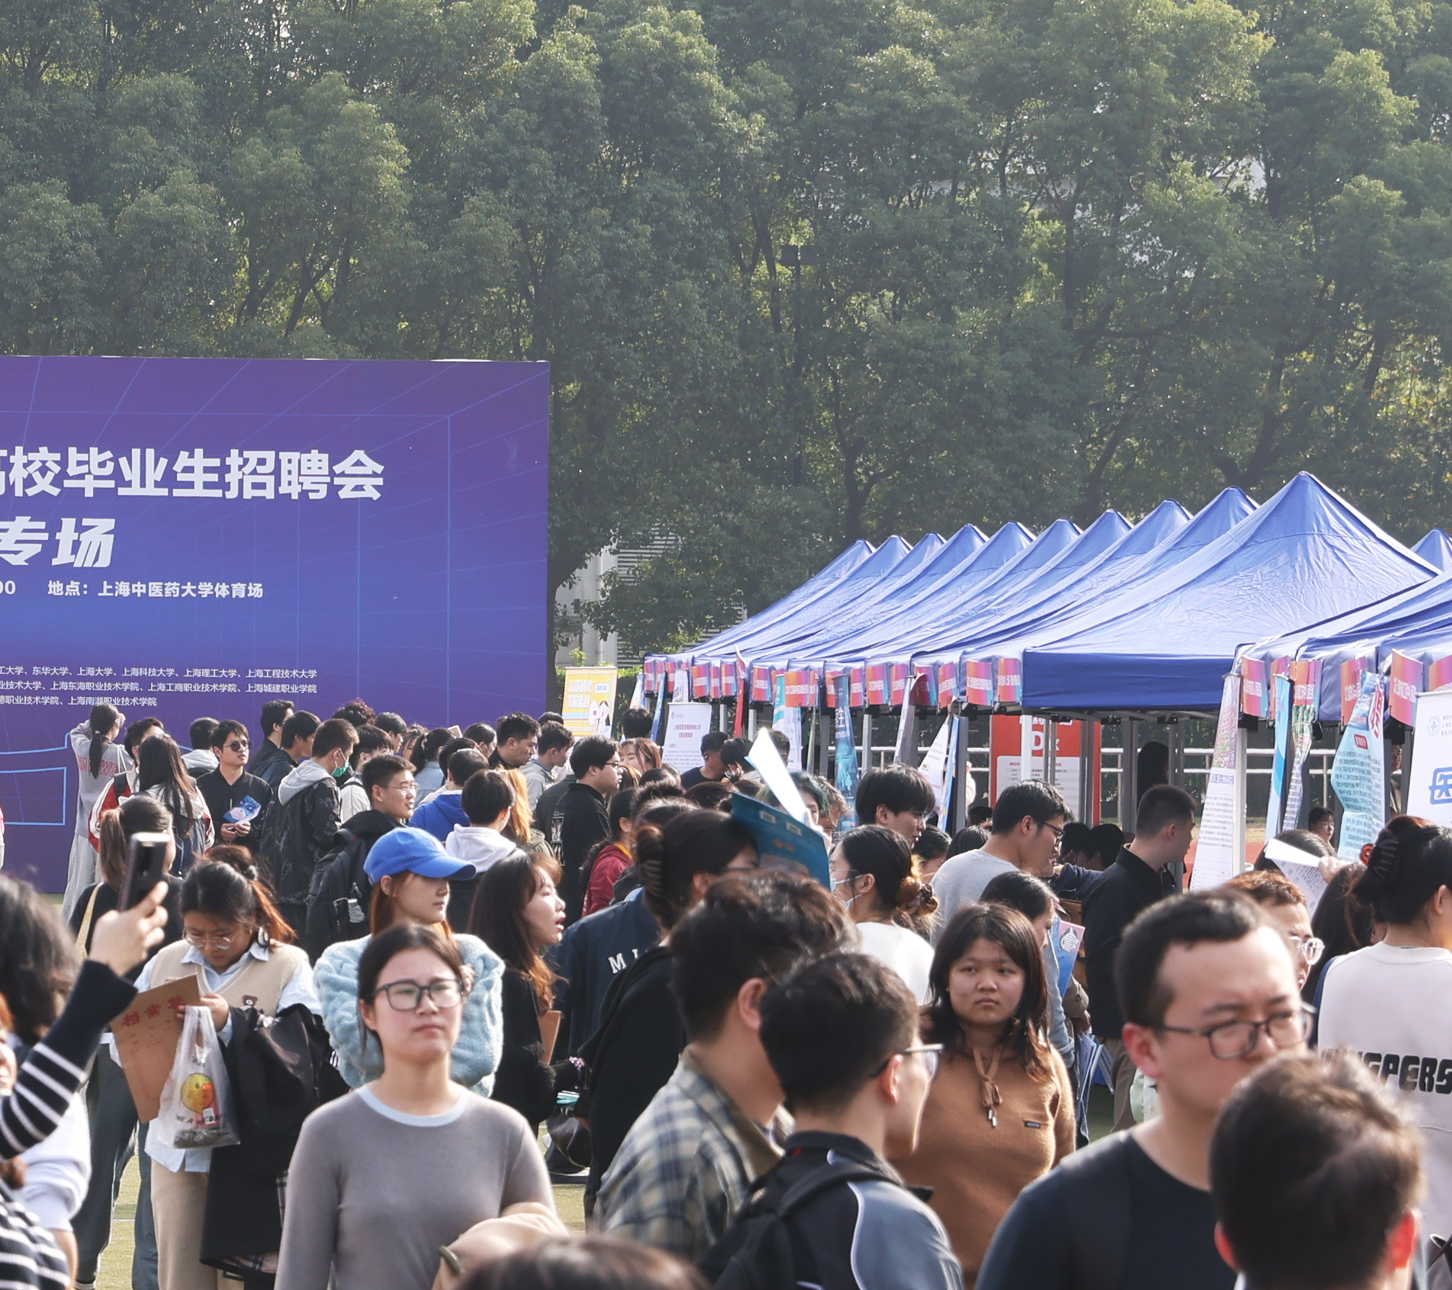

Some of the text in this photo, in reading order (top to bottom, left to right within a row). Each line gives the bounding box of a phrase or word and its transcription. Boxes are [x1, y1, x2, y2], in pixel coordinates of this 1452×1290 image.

[47, 580, 263, 599] 地点：上海中医药大学体育场
